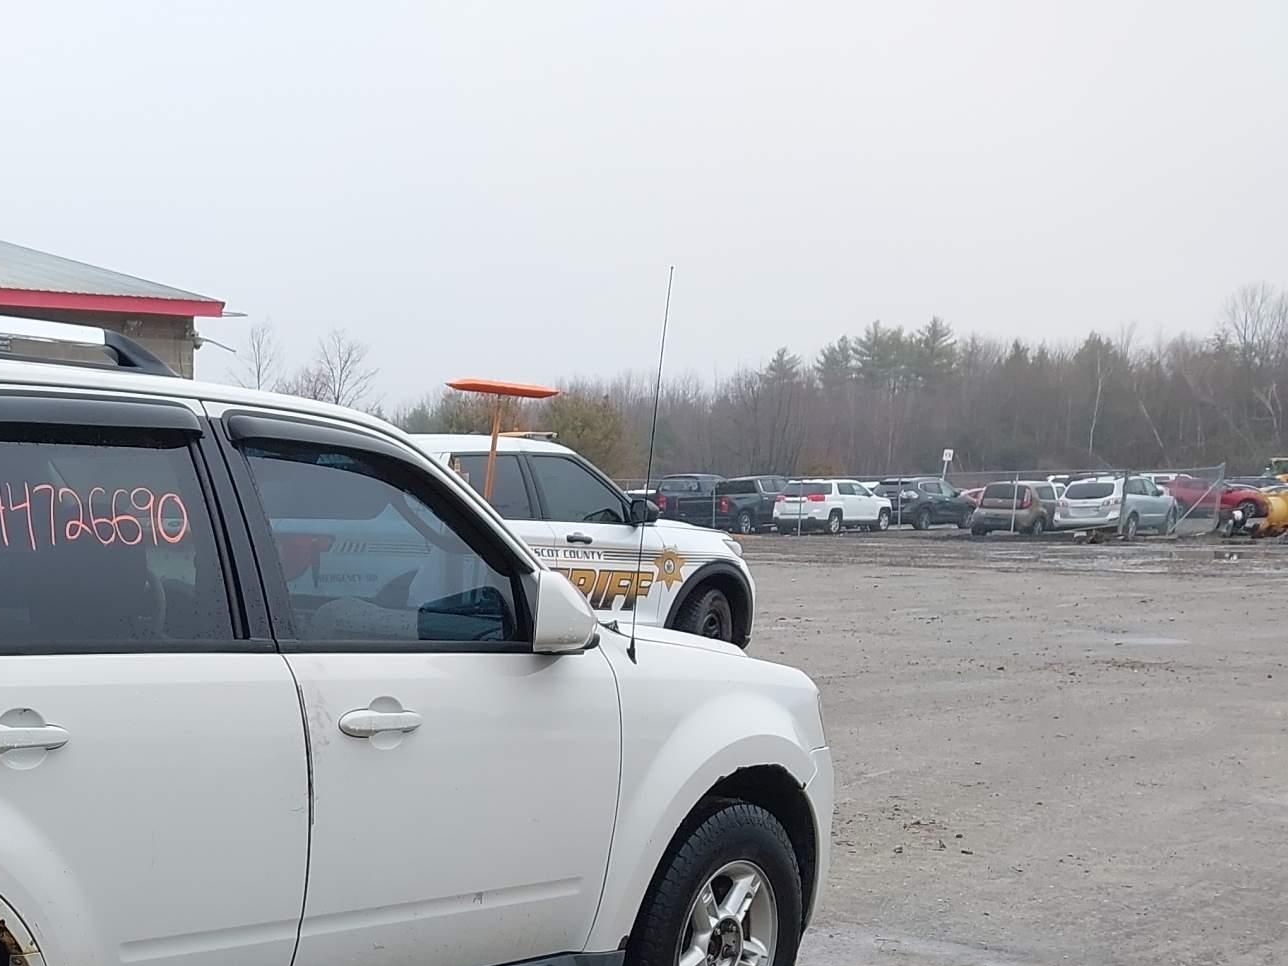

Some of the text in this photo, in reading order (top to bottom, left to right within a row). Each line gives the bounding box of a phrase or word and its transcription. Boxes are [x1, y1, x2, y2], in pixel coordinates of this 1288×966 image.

[531, 547, 605, 560] SCOT COUNTY
[548, 566, 655, 611] RIFF
